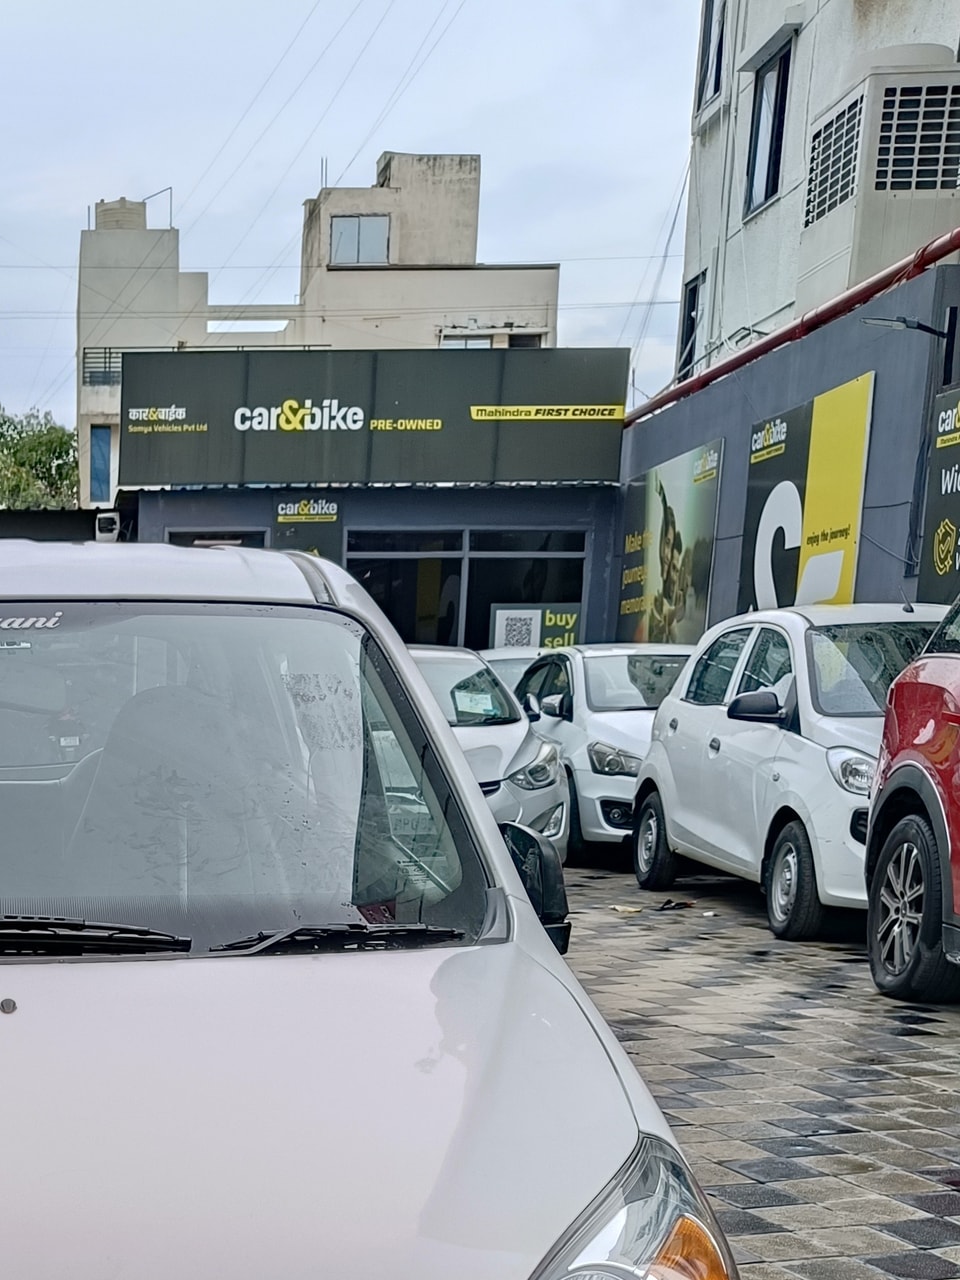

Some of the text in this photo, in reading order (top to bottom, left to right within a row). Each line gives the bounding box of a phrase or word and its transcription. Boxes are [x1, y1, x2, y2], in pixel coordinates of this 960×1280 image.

[234, 399, 442, 431] car&bike PRE-OWNED
[476, 408, 616, 417] Mahindra FIRST CHOICE
[153, 423, 182, 432] Vehicles
[751, 419, 787, 451] car&bike
[277, 499, 338, 515] car&bike
[545, 610, 577, 629] buy
[544, 633, 576, 649] sell
